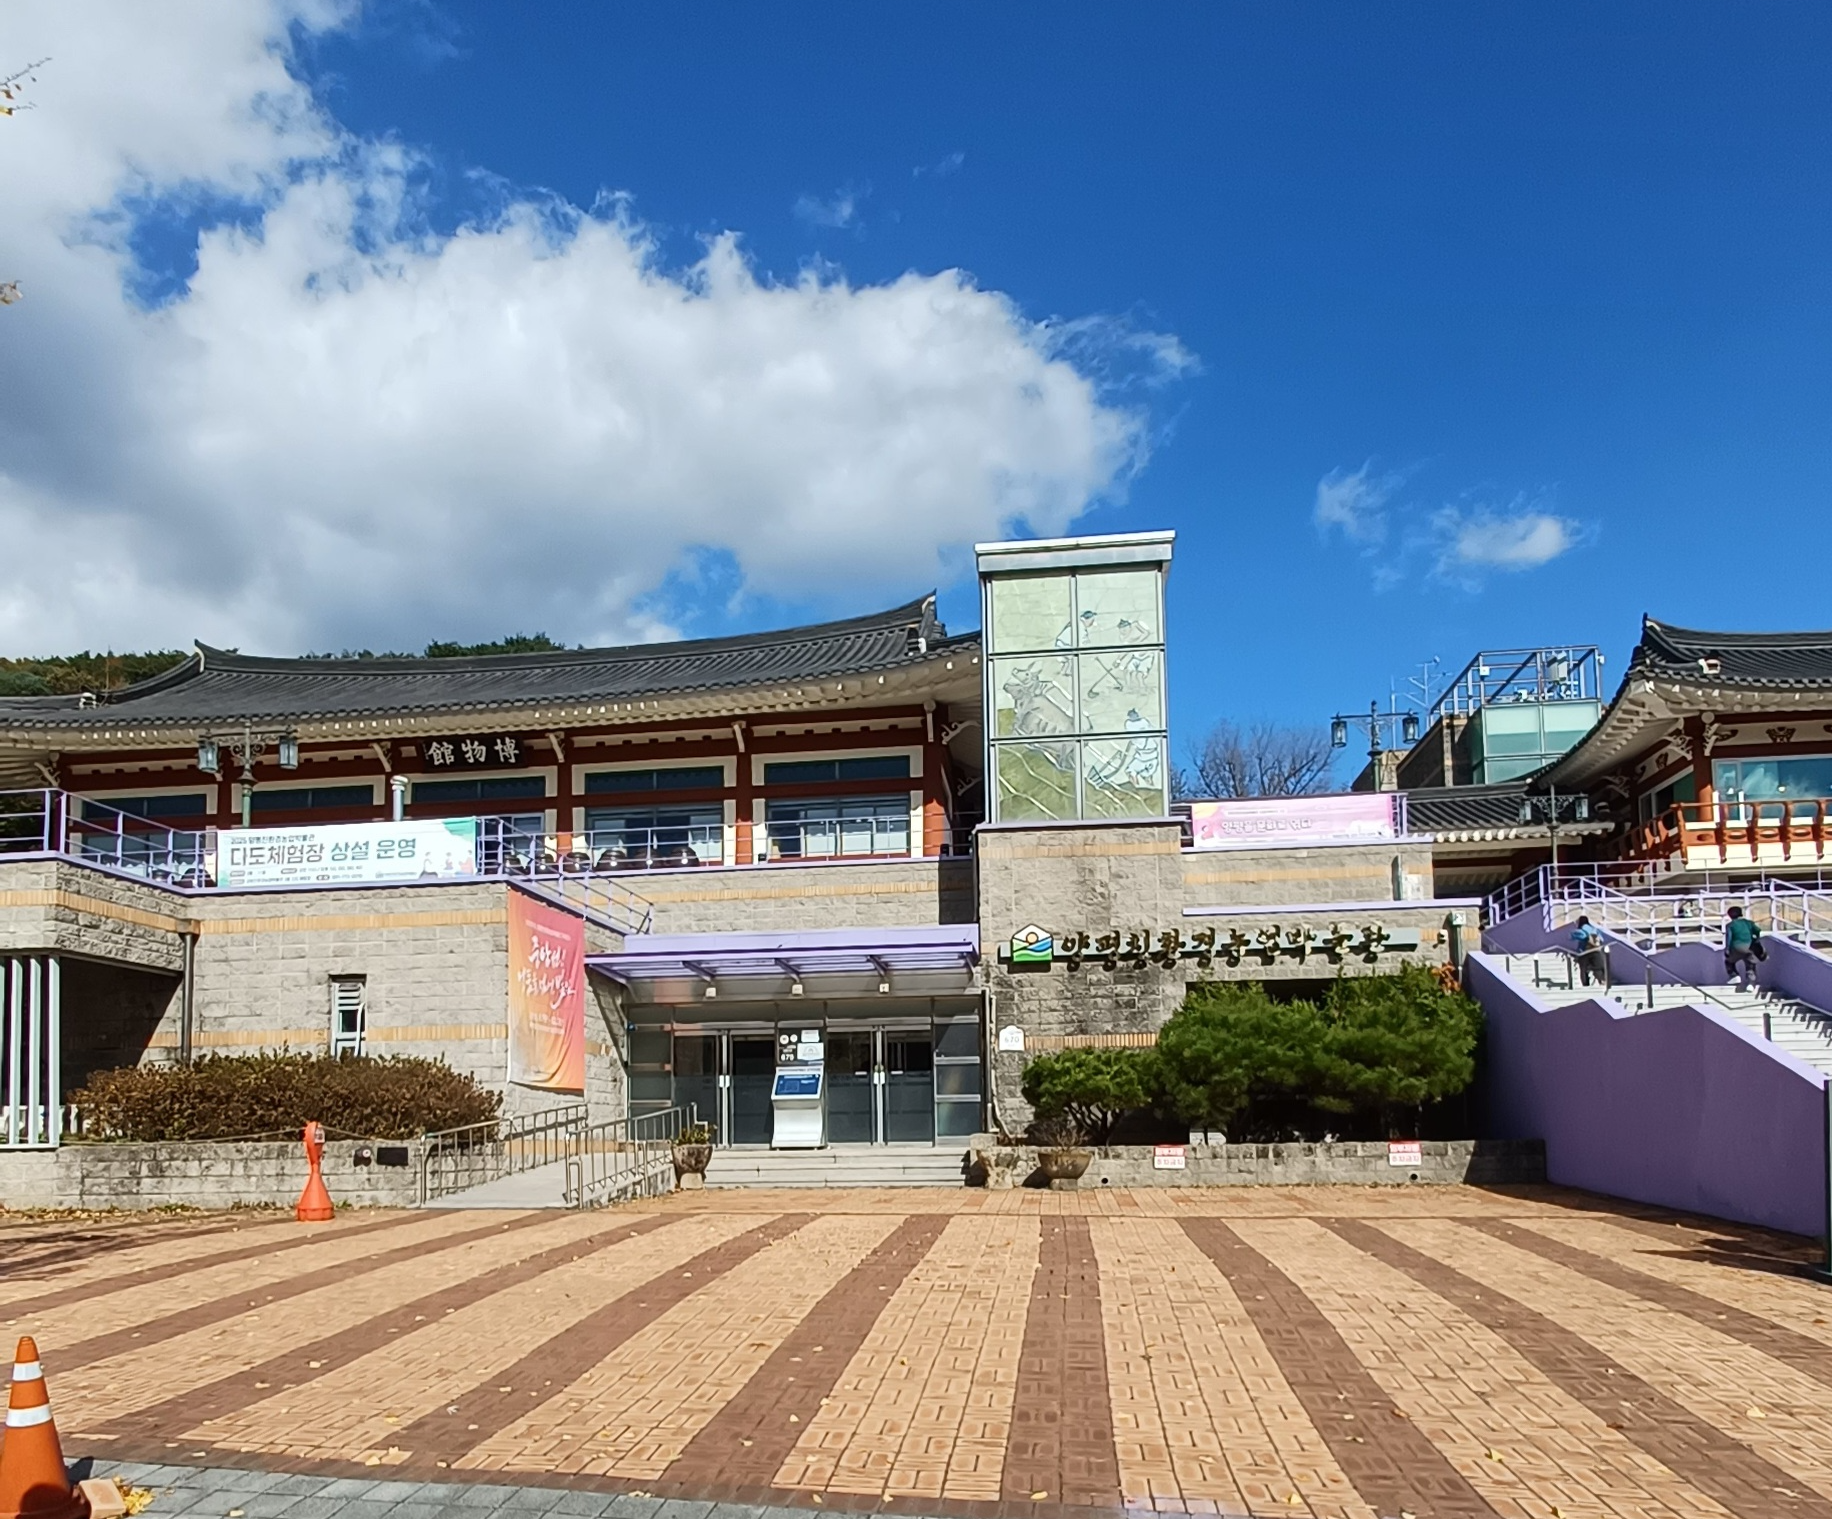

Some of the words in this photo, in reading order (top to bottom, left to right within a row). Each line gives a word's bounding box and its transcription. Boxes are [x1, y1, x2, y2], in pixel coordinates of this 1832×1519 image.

[230, 843, 325, 866] 다도체험장
[331, 840, 370, 862] 상설
[376, 838, 417, 859] 운영
